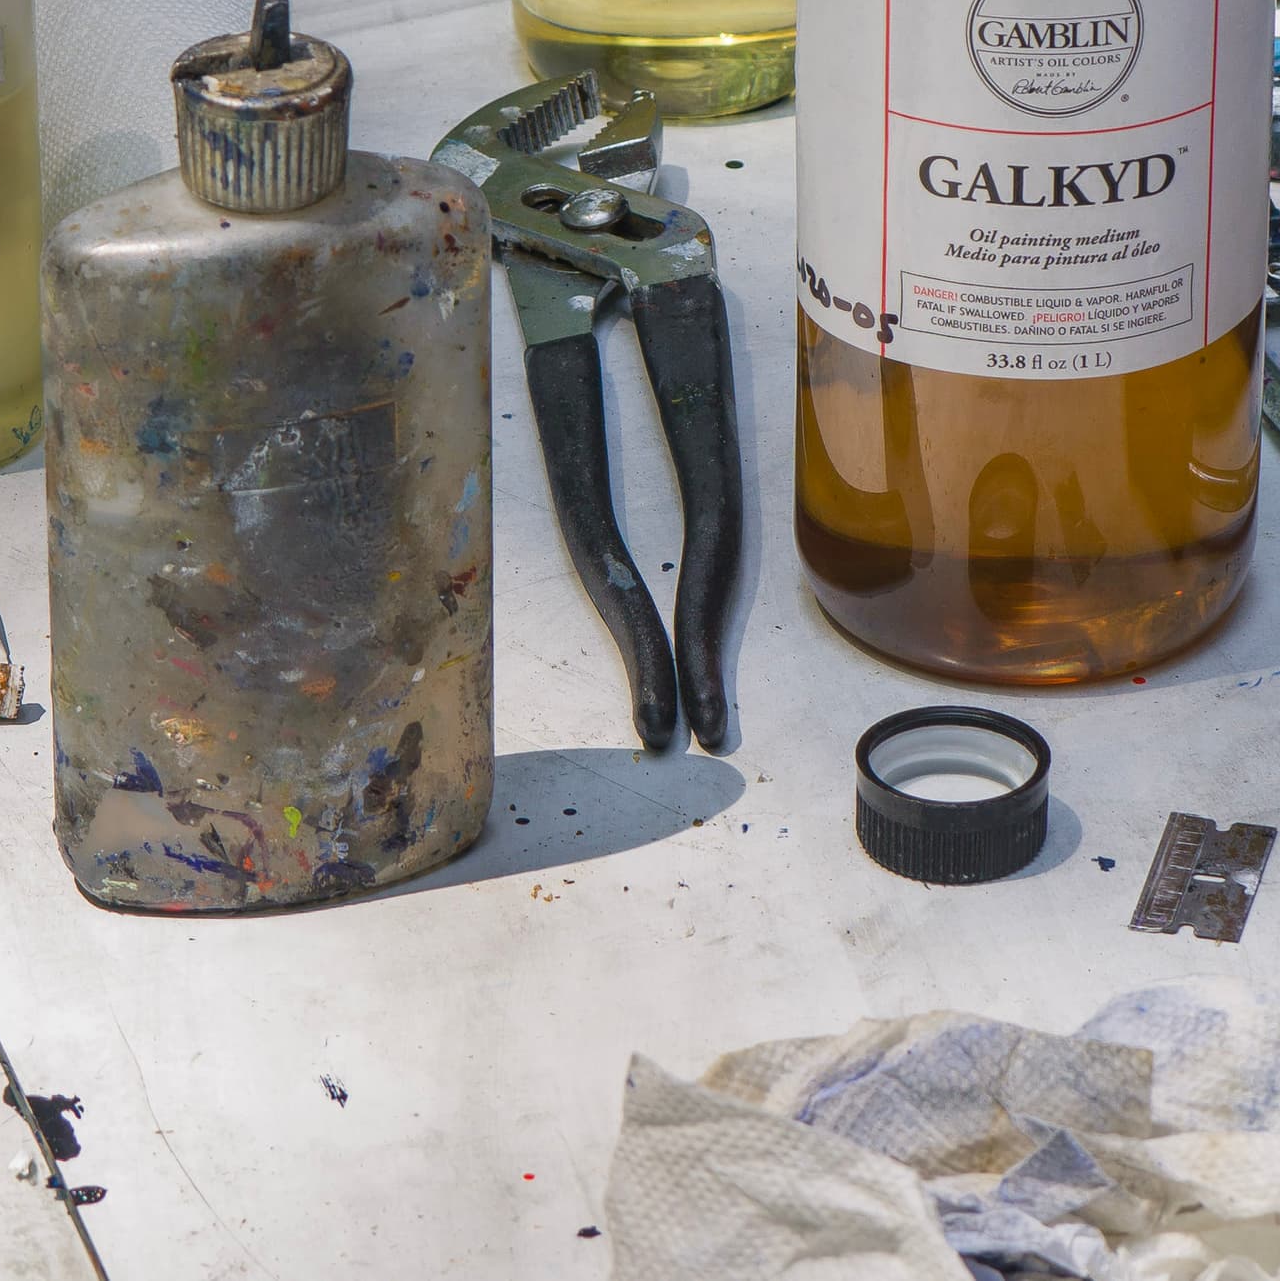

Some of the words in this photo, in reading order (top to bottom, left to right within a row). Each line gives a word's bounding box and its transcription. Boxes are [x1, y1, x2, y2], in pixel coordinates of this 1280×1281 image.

[978, 16, 1132, 49] GAMBLIN
[990, 57, 1044, 67] ARTIST'S
[1047, 58, 1069, 67] OIL
[1072, 54, 1121, 66] COLORS
[970, 228, 997, 244] Oil
[999, 232, 1072, 250] painting
[1075, 227, 1140, 247] medium
[944, 243, 997, 263] Medio
[999, 252, 1041, 267] para
[1043, 251, 1107, 269] pintura
[1112, 245, 1128, 260] al
[1131, 241, 1161, 257] óleo
[913, 285, 958, 302] DANGER!
[960, 293, 1033, 308] COMBUSTIBLE
[1036, 298, 1071, 309] LIQUID
[1075, 297, 1083, 307] &
[1086, 294, 1122, 307] VAPOR.
[1125, 283, 1170, 301] HARMFUL
[1171, 278, 1184, 289] OR
[917, 300, 945, 313] FATAL
[948, 305, 957, 315] IF
[1031, 311, 1086, 325] ¡PELIGRO!
[1088, 305, 1130, 320] LÍQUIDO
[1132, 304, 1140, 314] Y
[1141, 293, 1181, 312] VAPORES
[930, 316, 1011, 335] COMBUSTIBLES.
[1013, 323, 1055, 336] DAÑINO
[1058, 326, 1067, 336] O
[1069, 324, 1099, 335] FATAL
[1101, 323, 1110, 333] SI
[1112, 321, 1125, 332] SE
[1127, 311, 1168, 328] INGIERE.
[986, 352, 1026, 369] 33.8
[1031, 353, 1042, 369] fl
[1048, 359, 1067, 370] oz
[1073, 353, 1088, 370] (1
[1095, 351, 1113, 368] L)
